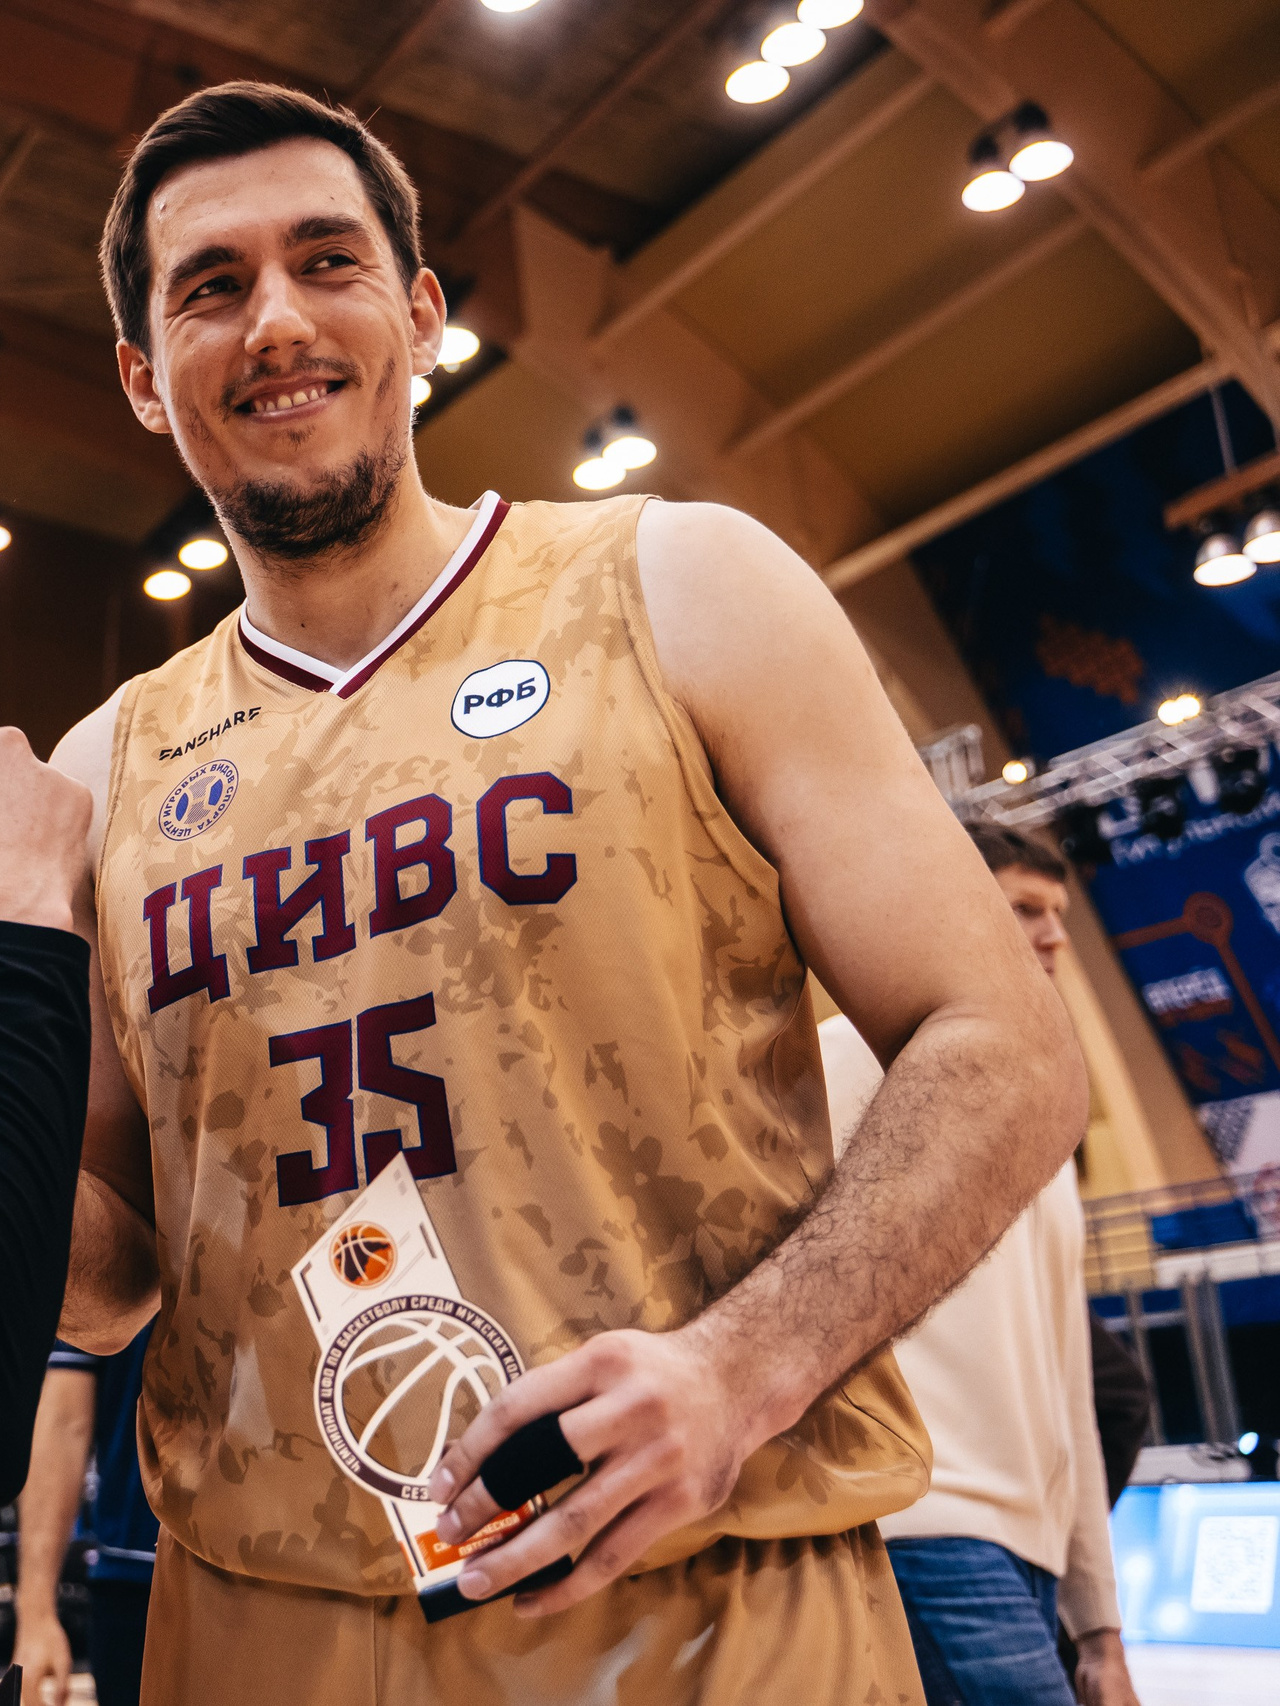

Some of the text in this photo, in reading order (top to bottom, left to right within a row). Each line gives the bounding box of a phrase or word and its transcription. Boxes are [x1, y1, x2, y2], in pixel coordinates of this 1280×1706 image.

[463, 677, 536, 715] РФБ
[163, 763, 235, 837] ЦЕНТР ИГРОВЫХ ВИДОВ СПОРТА
[143, 771, 578, 1015] ЦИВС
[268, 991, 457, 1207] 35
[335, 1297, 408, 1349] БАСКЕТБОЛУ
[410, 1295, 455, 1314] СРЕДИ
[455, 1306, 508, 1358] МУЖСКИХ
[320, 1369, 335, 1398] ЦФО
[326, 1350, 343, 1368] ПО
[320, 1401, 361, 1473] ЧЕМПИОНАТ
